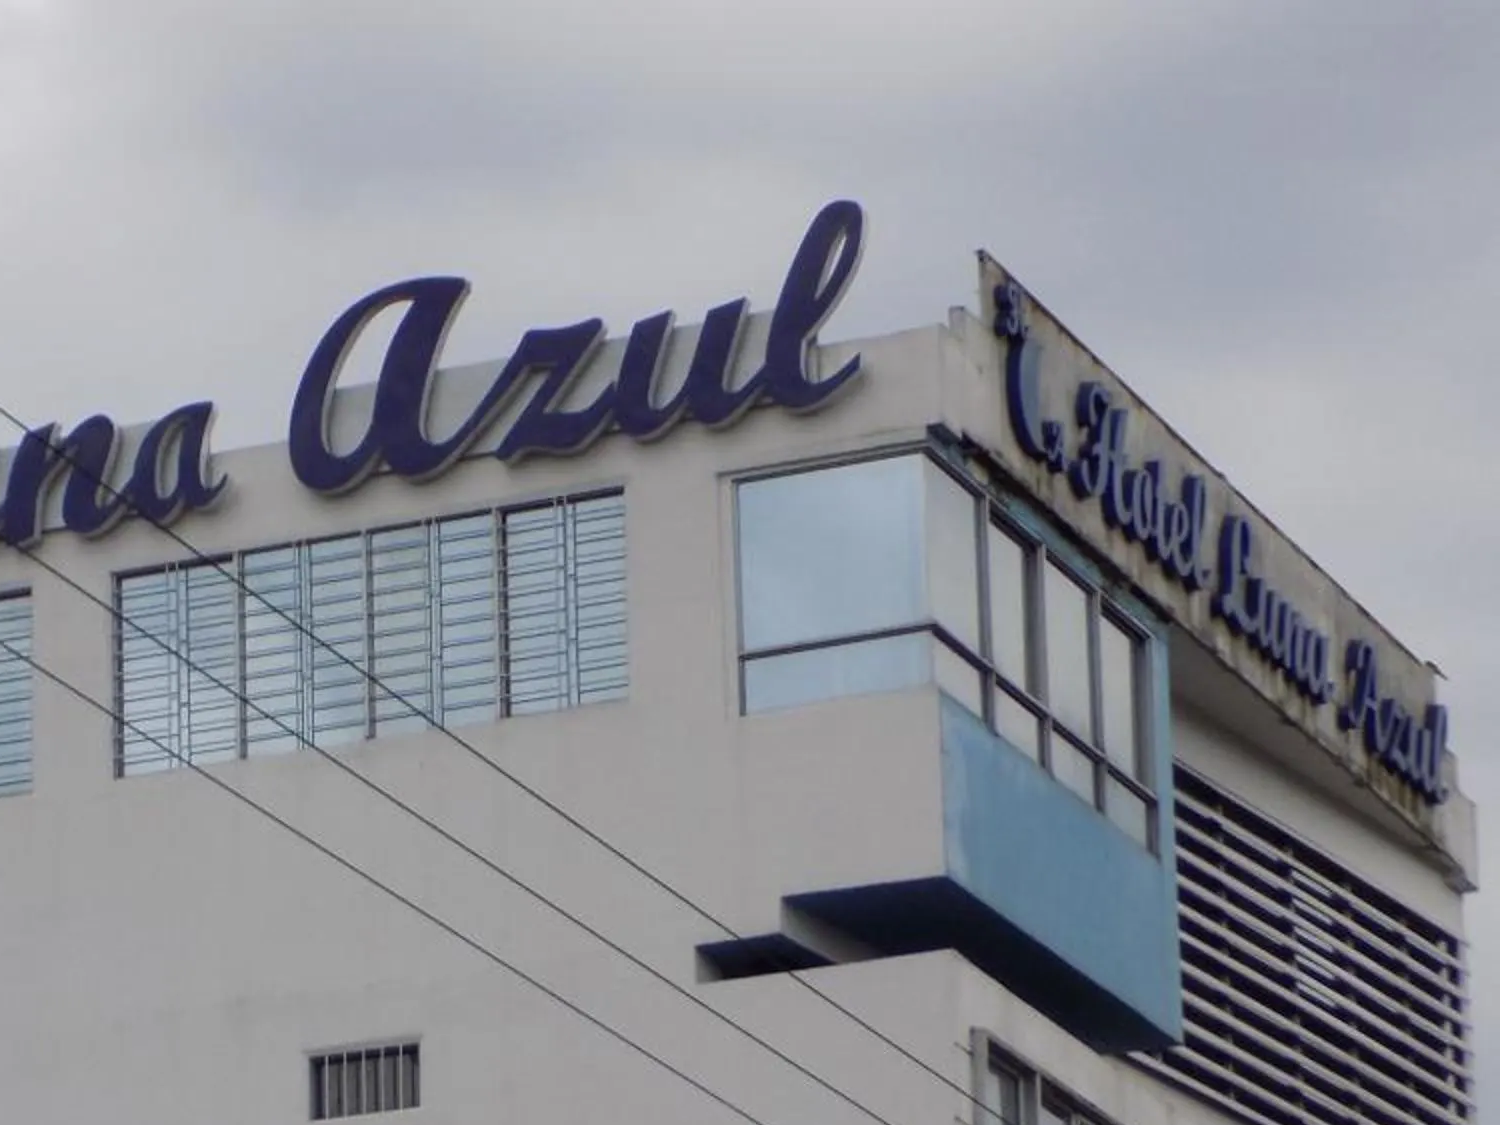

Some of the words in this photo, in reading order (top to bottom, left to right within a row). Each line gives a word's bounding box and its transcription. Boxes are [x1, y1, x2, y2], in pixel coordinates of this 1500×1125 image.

[288, 199, 864, 496] Azul
[1069, 380, 1211, 591] Hotel
[1210, 513, 1335, 705] Luna
[1337, 638, 1449, 806] Azul
